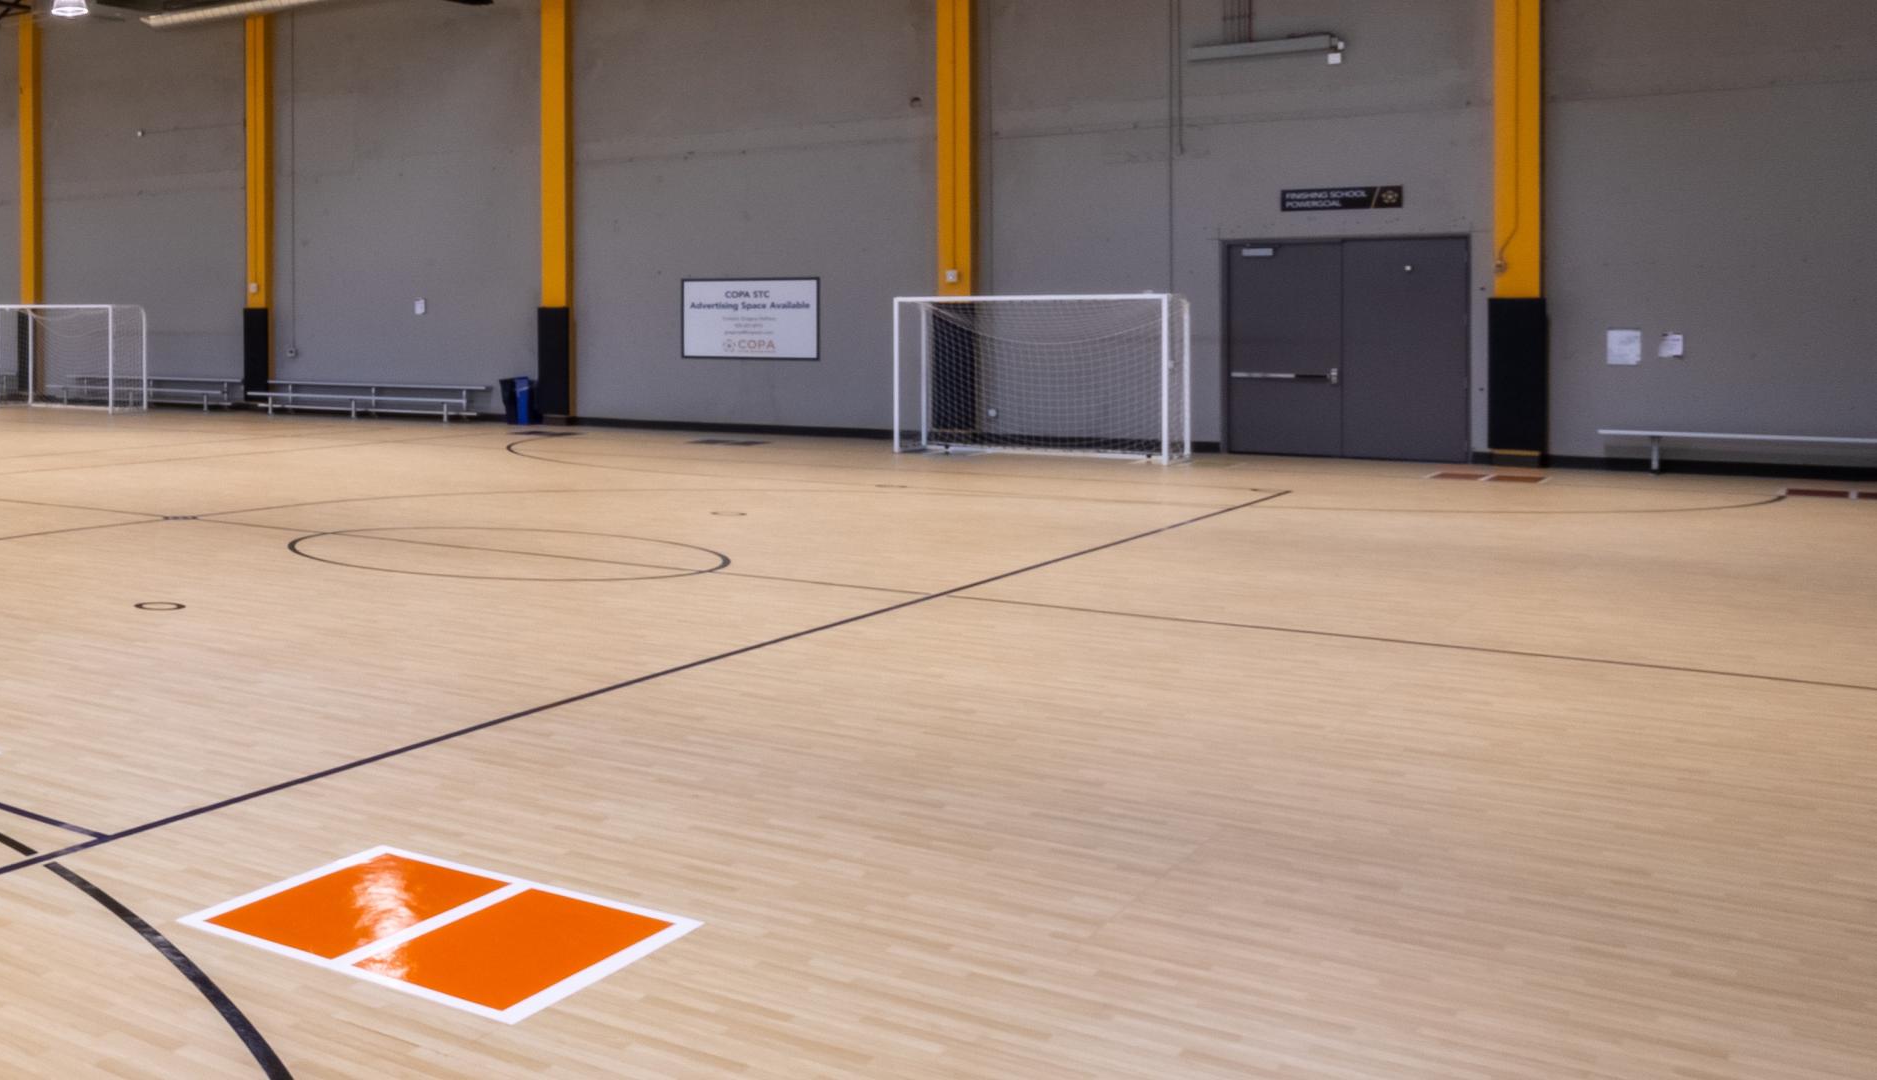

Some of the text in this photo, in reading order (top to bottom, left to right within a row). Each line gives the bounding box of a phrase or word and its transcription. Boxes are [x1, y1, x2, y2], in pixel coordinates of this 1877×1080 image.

[1330, 190, 1367, 198] SCHOOL
[724, 290, 771, 299] COPA STC
[689, 301, 811, 311] Advertising Space Available
[737, 339, 777, 350] COPA
